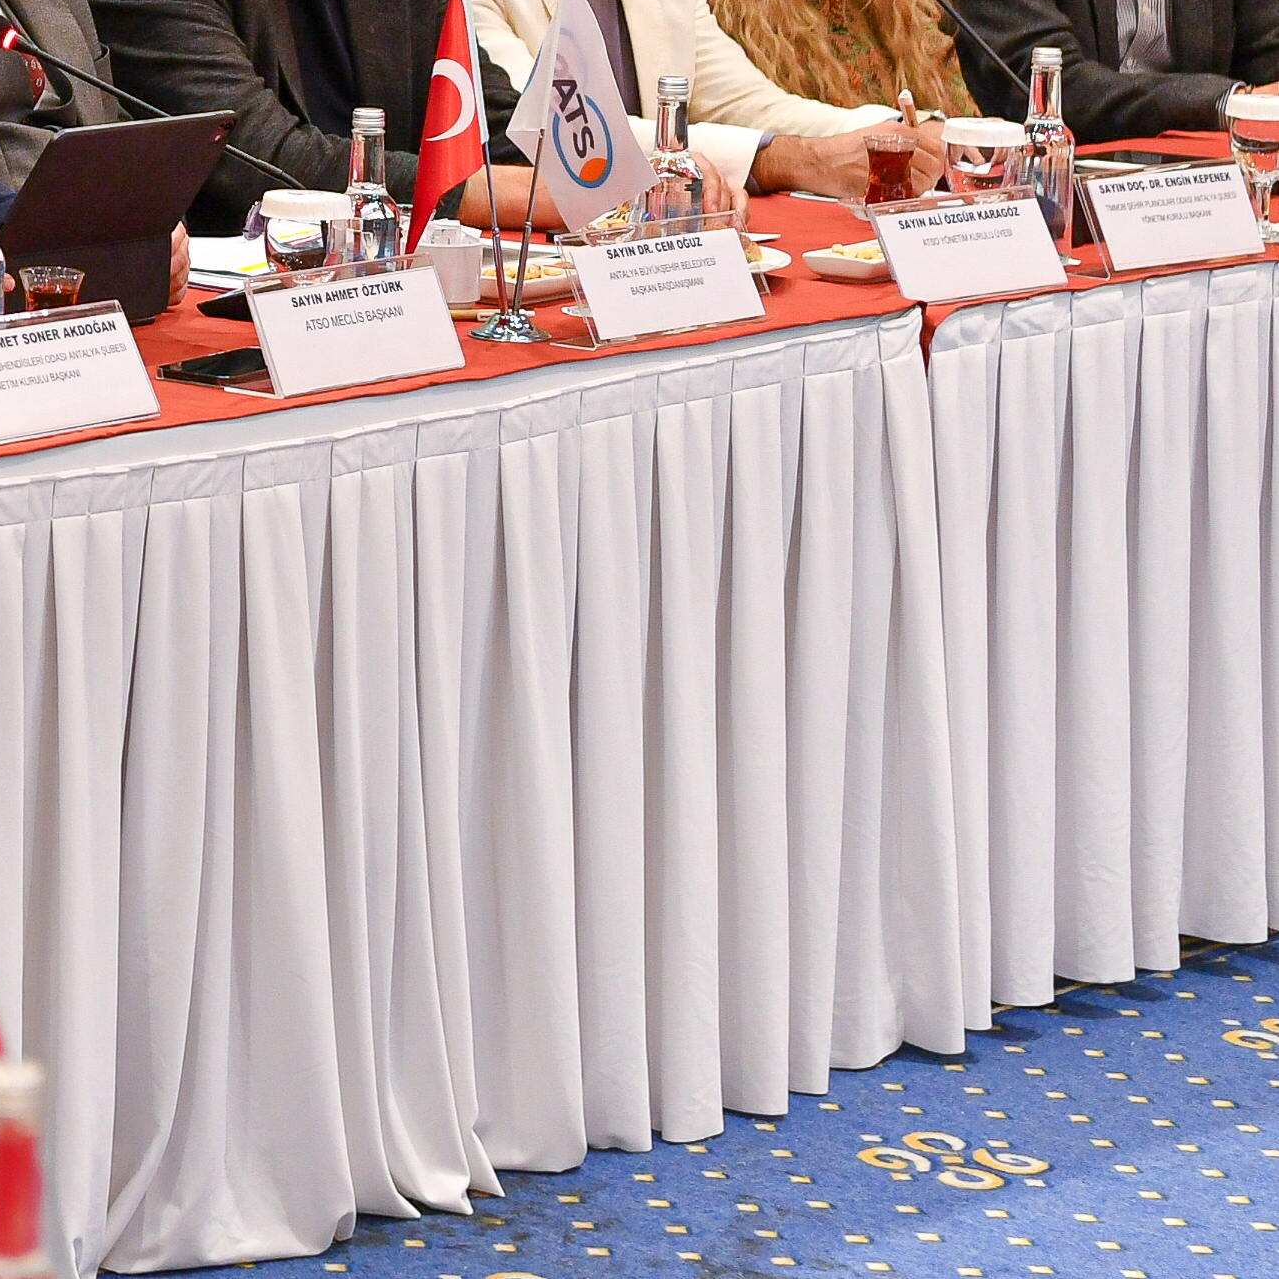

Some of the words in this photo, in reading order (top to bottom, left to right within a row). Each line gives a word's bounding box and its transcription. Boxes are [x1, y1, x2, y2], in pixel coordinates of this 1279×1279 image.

[1098, 183, 1126, 195] SAYIN
[1126, 180, 1148, 193] DOÇ.
[1148, 178, 1164, 189] DR.
[1164, 174, 1192, 188] ENGİN
[1192, 171, 1232, 184] KEPENEK
[897, 218, 927, 230] SAYIN
[928, 213, 943, 226] ALİ
[943, 210, 976, 225] ÖZGÜR
[976, 206, 1020, 220] KARAGÖZ
[606, 245, 636, 260] SAYIN
[637, 243, 654, 255] DR.
[654, 240, 676, 253] CEM
[676, 236, 703, 250] OĞUZ
[609, 267, 640, 280] ANTALYA
[639, 260, 680, 276] BÜYÜKŞEHİR
[680, 255, 717, 270] BELEDİYESİ
[291, 292, 323, 308] SAYIN
[325, 287, 359, 303] AHMET
[361, 280, 404, 297] ÖZTÜRK
[630, 283, 658, 296] BAŞKAN
[657, 277, 705, 292] BAŞDANIŞMANI
[305, 316, 330, 331] ATSO
[330, 310, 365, 327] MECLİS
[364, 305, 404, 322] BAŞKANI
[21, 327, 61, 345] SONER
[63, 319, 117, 339] AKDOĞAN
[44, 352, 68, 364] ODASI
[68, 346, 101, 361] ANTALYA
[100, 342, 128, 357] ŞUBESİ
[20, 373, 49, 386] KURULU
[49, 368, 81, 382] BAŞKANI
